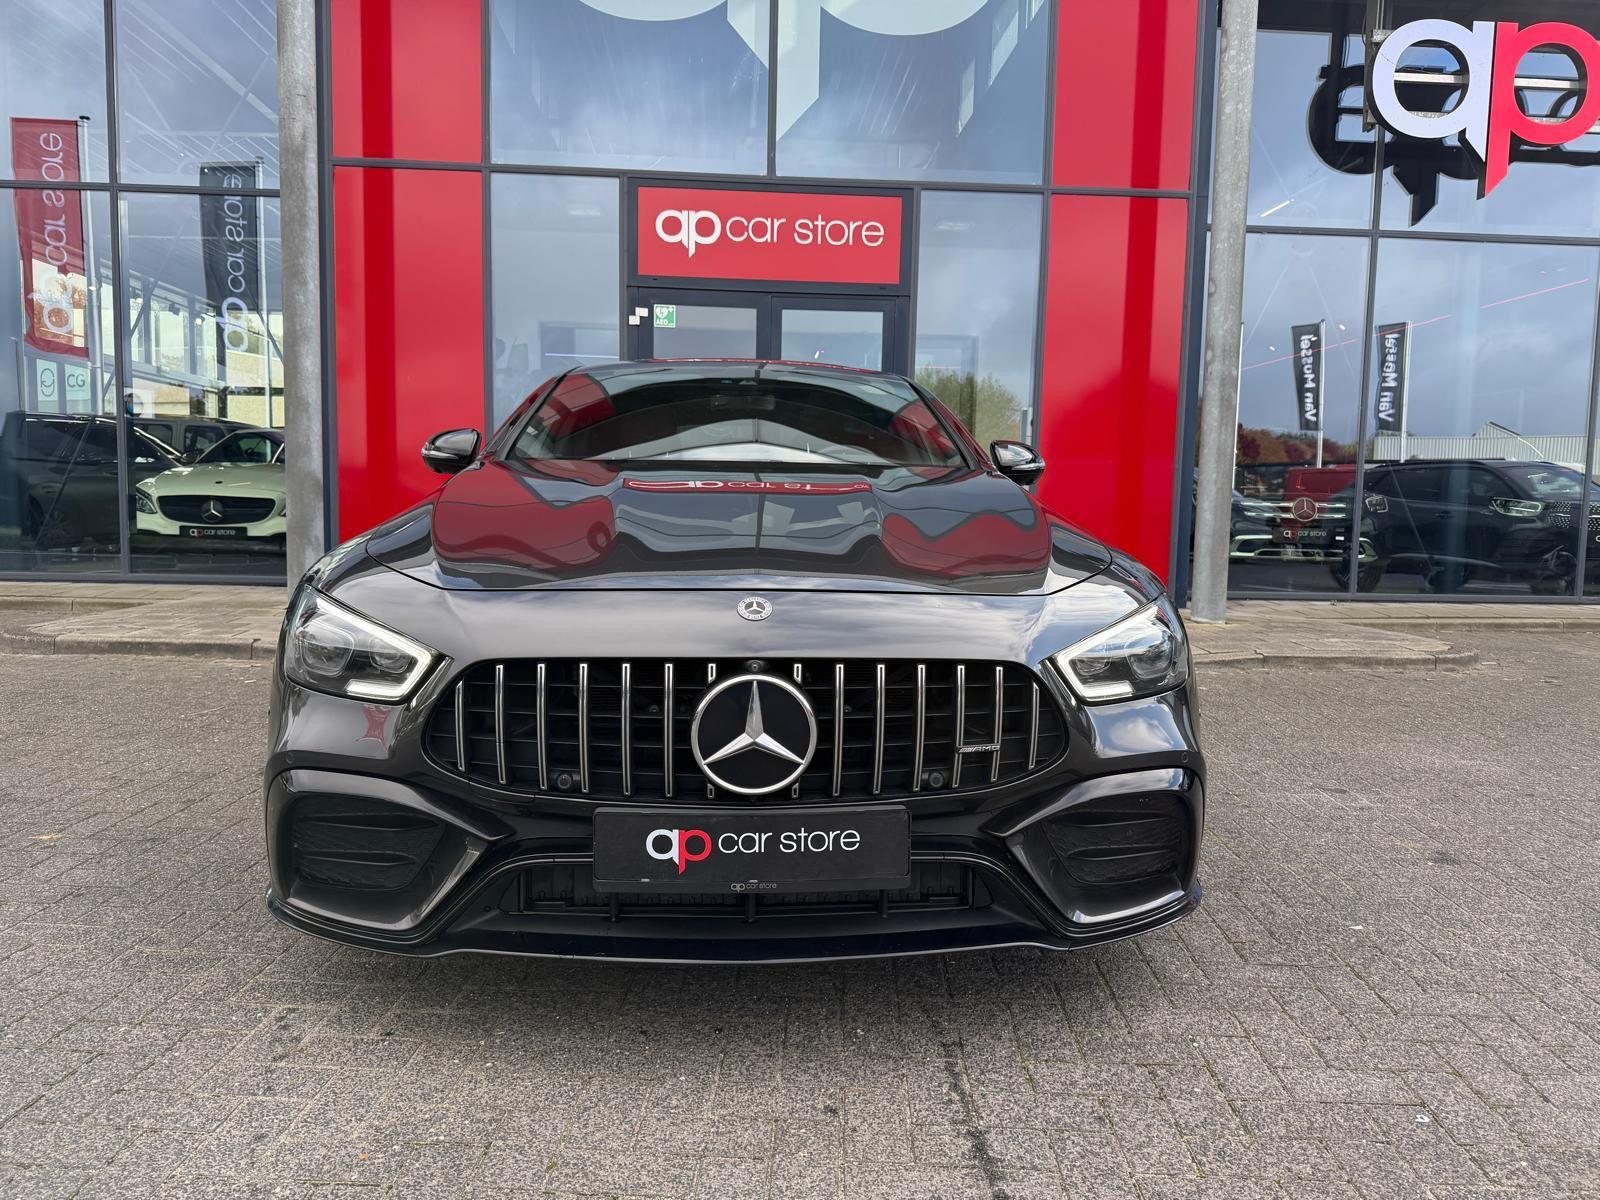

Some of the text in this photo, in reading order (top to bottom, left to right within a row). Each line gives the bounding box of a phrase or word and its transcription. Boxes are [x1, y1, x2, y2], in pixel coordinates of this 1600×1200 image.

[655, 209, 885, 259] ap car store
[645, 827, 861, 875] ap car store
